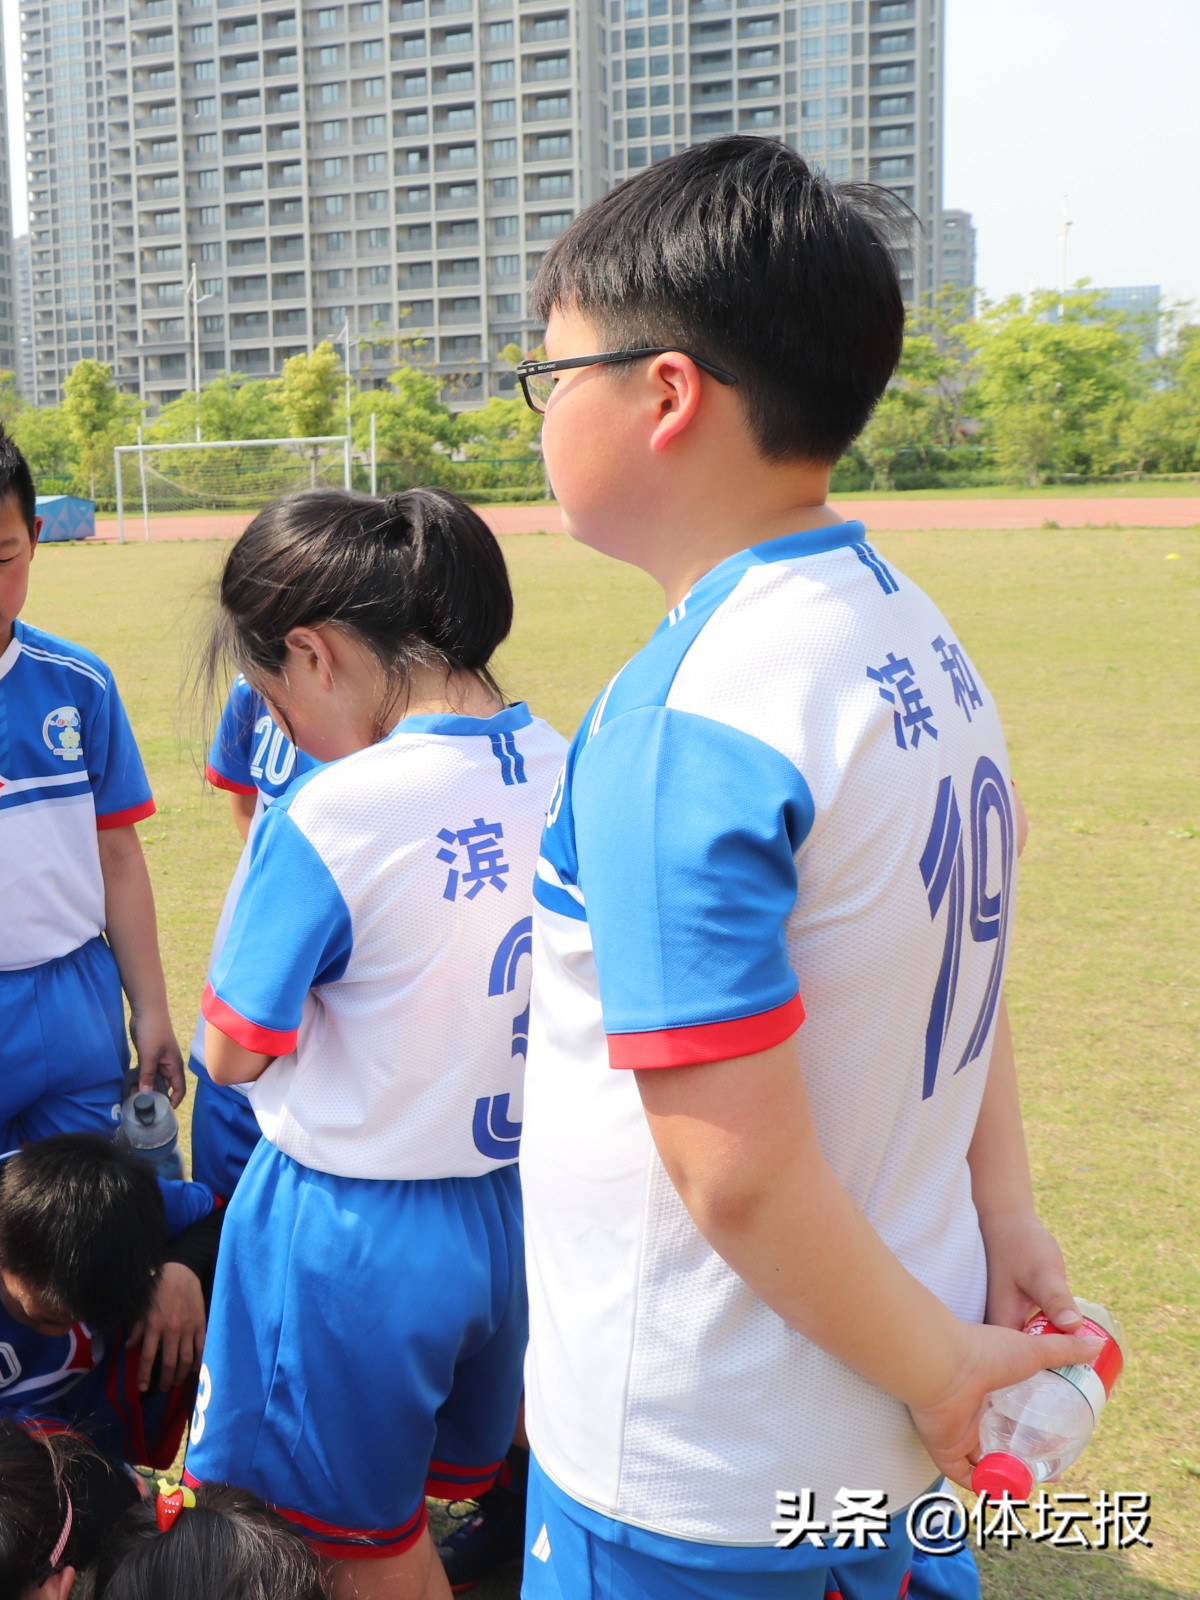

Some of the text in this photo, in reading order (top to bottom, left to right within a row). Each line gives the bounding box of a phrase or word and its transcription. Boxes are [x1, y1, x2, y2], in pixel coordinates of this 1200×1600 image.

[866, 635, 984, 751] 滨和
[250, 715, 297, 785] 20
[436, 818, 509, 902] 滨
[919, 756, 1017, 1102] 19
